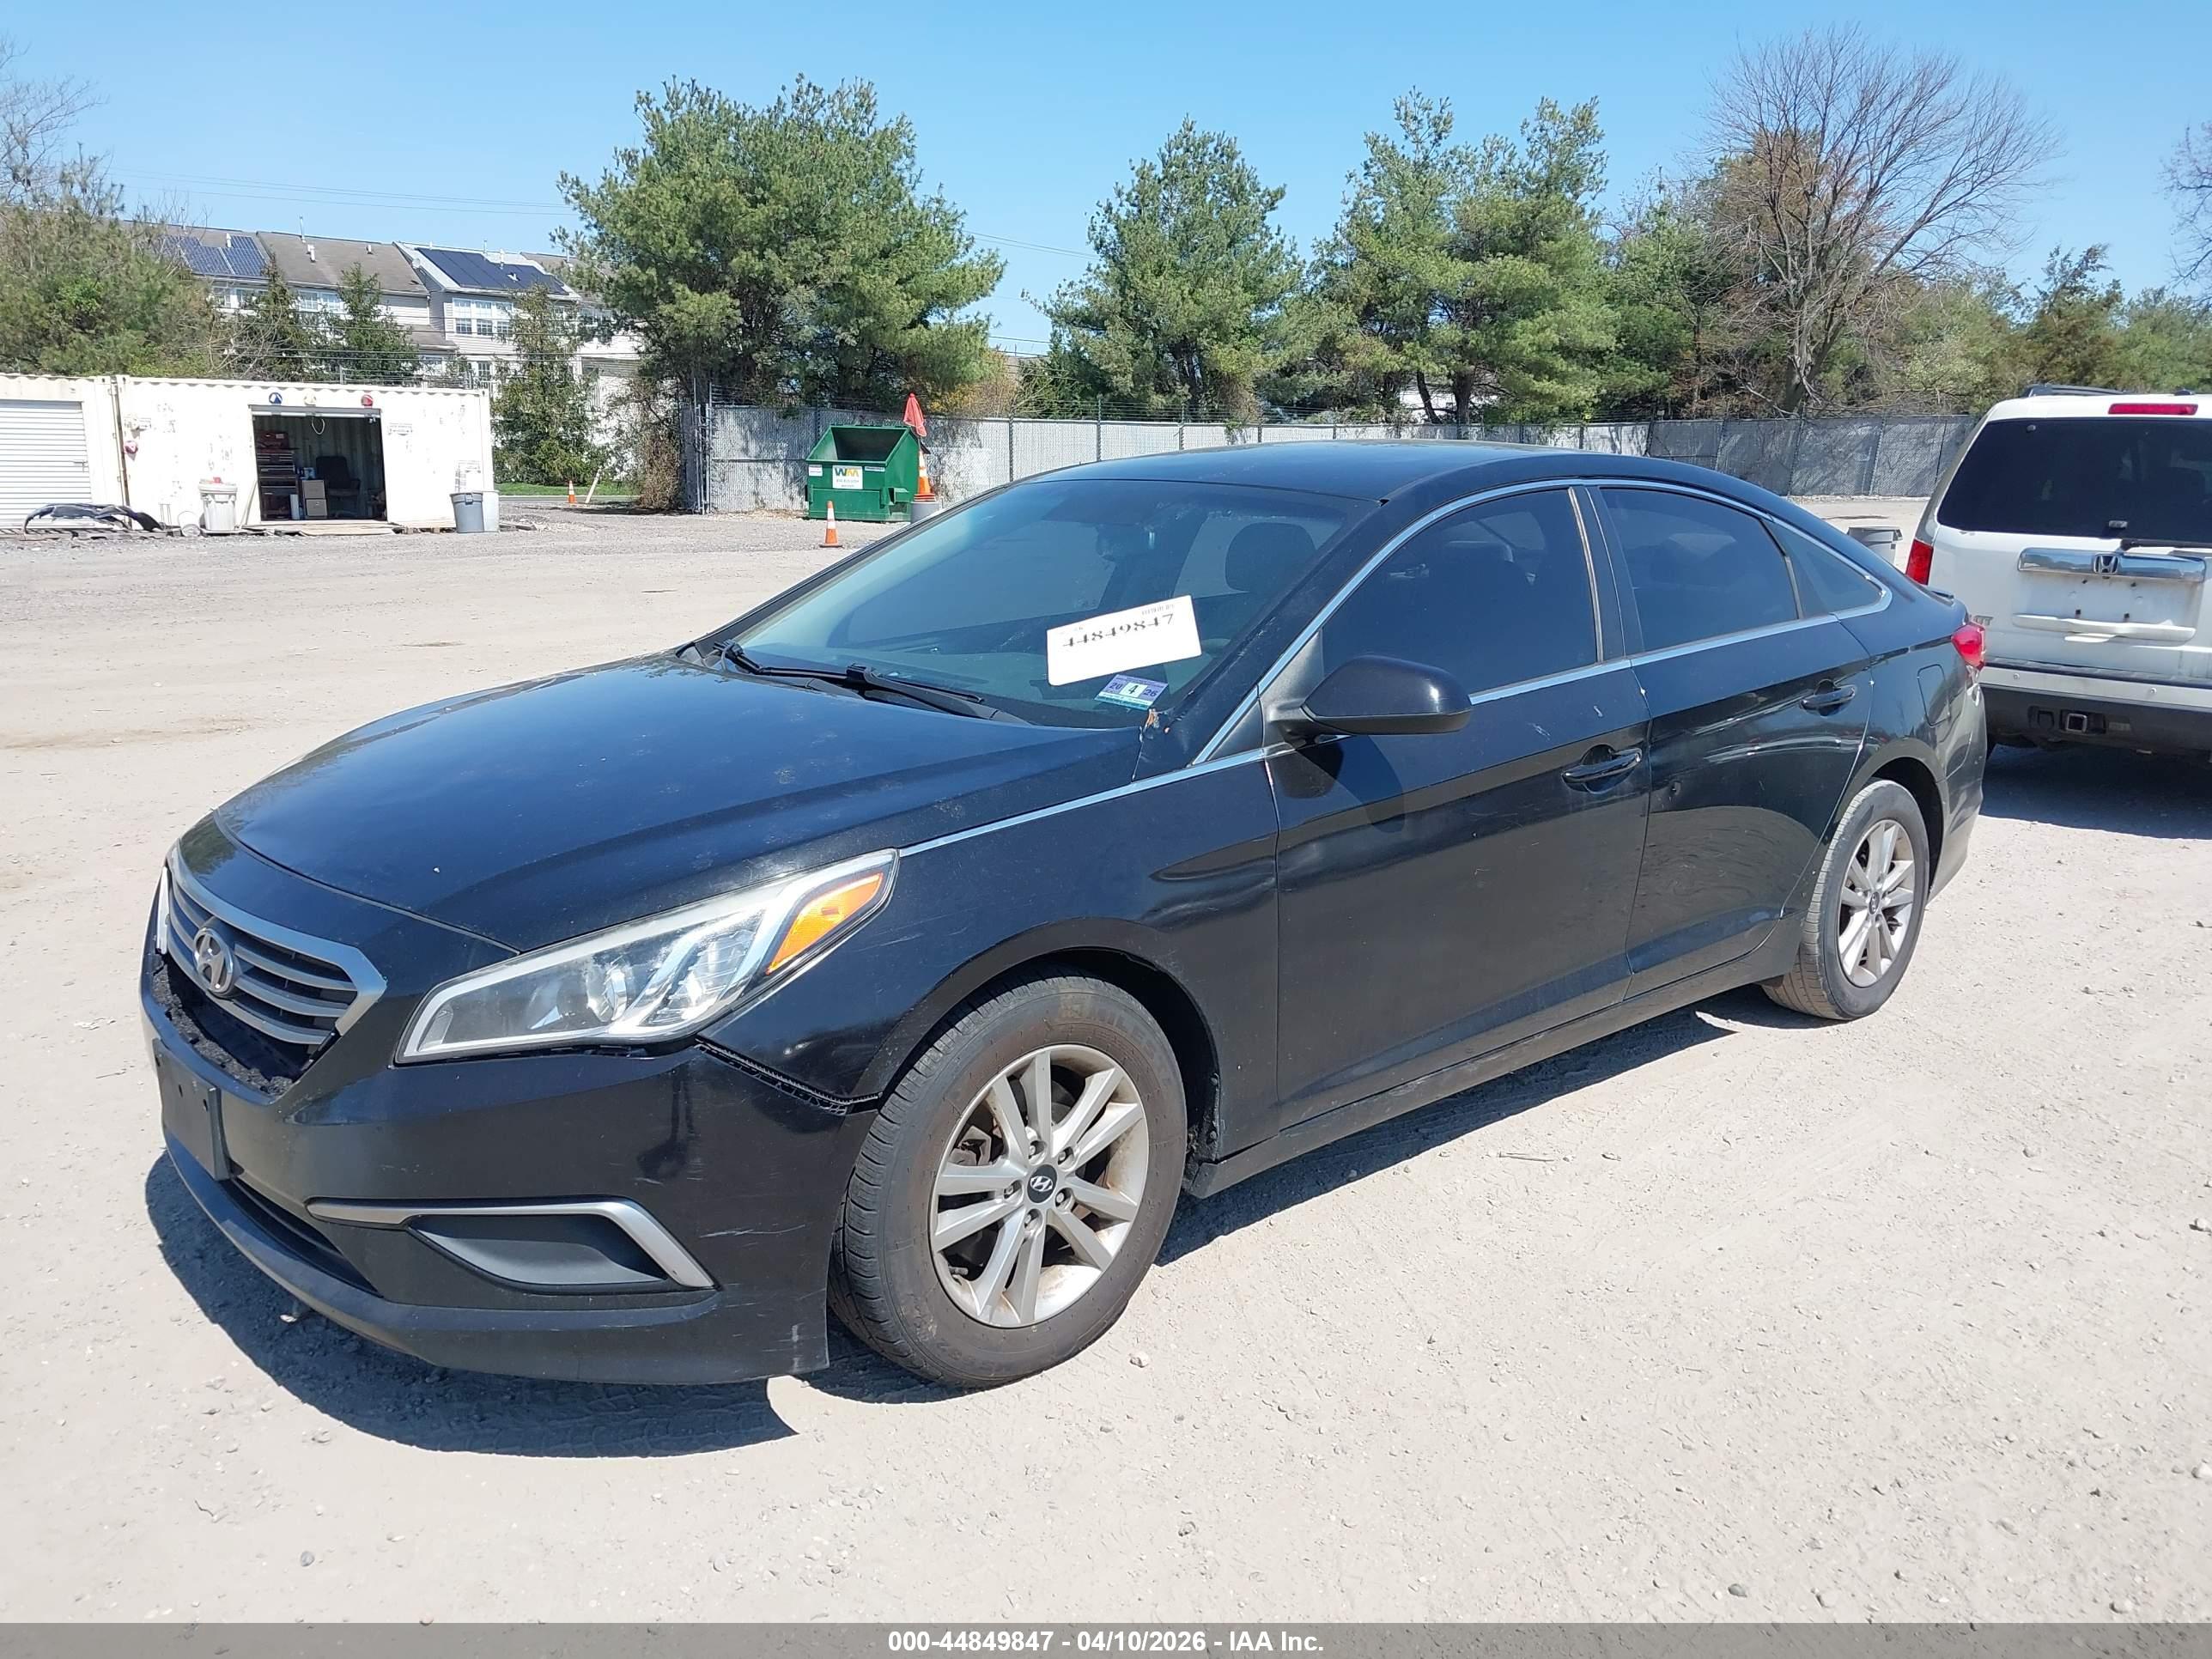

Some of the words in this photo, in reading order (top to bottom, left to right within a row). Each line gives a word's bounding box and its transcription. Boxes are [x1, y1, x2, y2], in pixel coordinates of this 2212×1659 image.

[1063, 613, 1174, 647] 44849847
[1127, 684, 1139, 695] 4
[1143, 689, 1158, 697] 26
